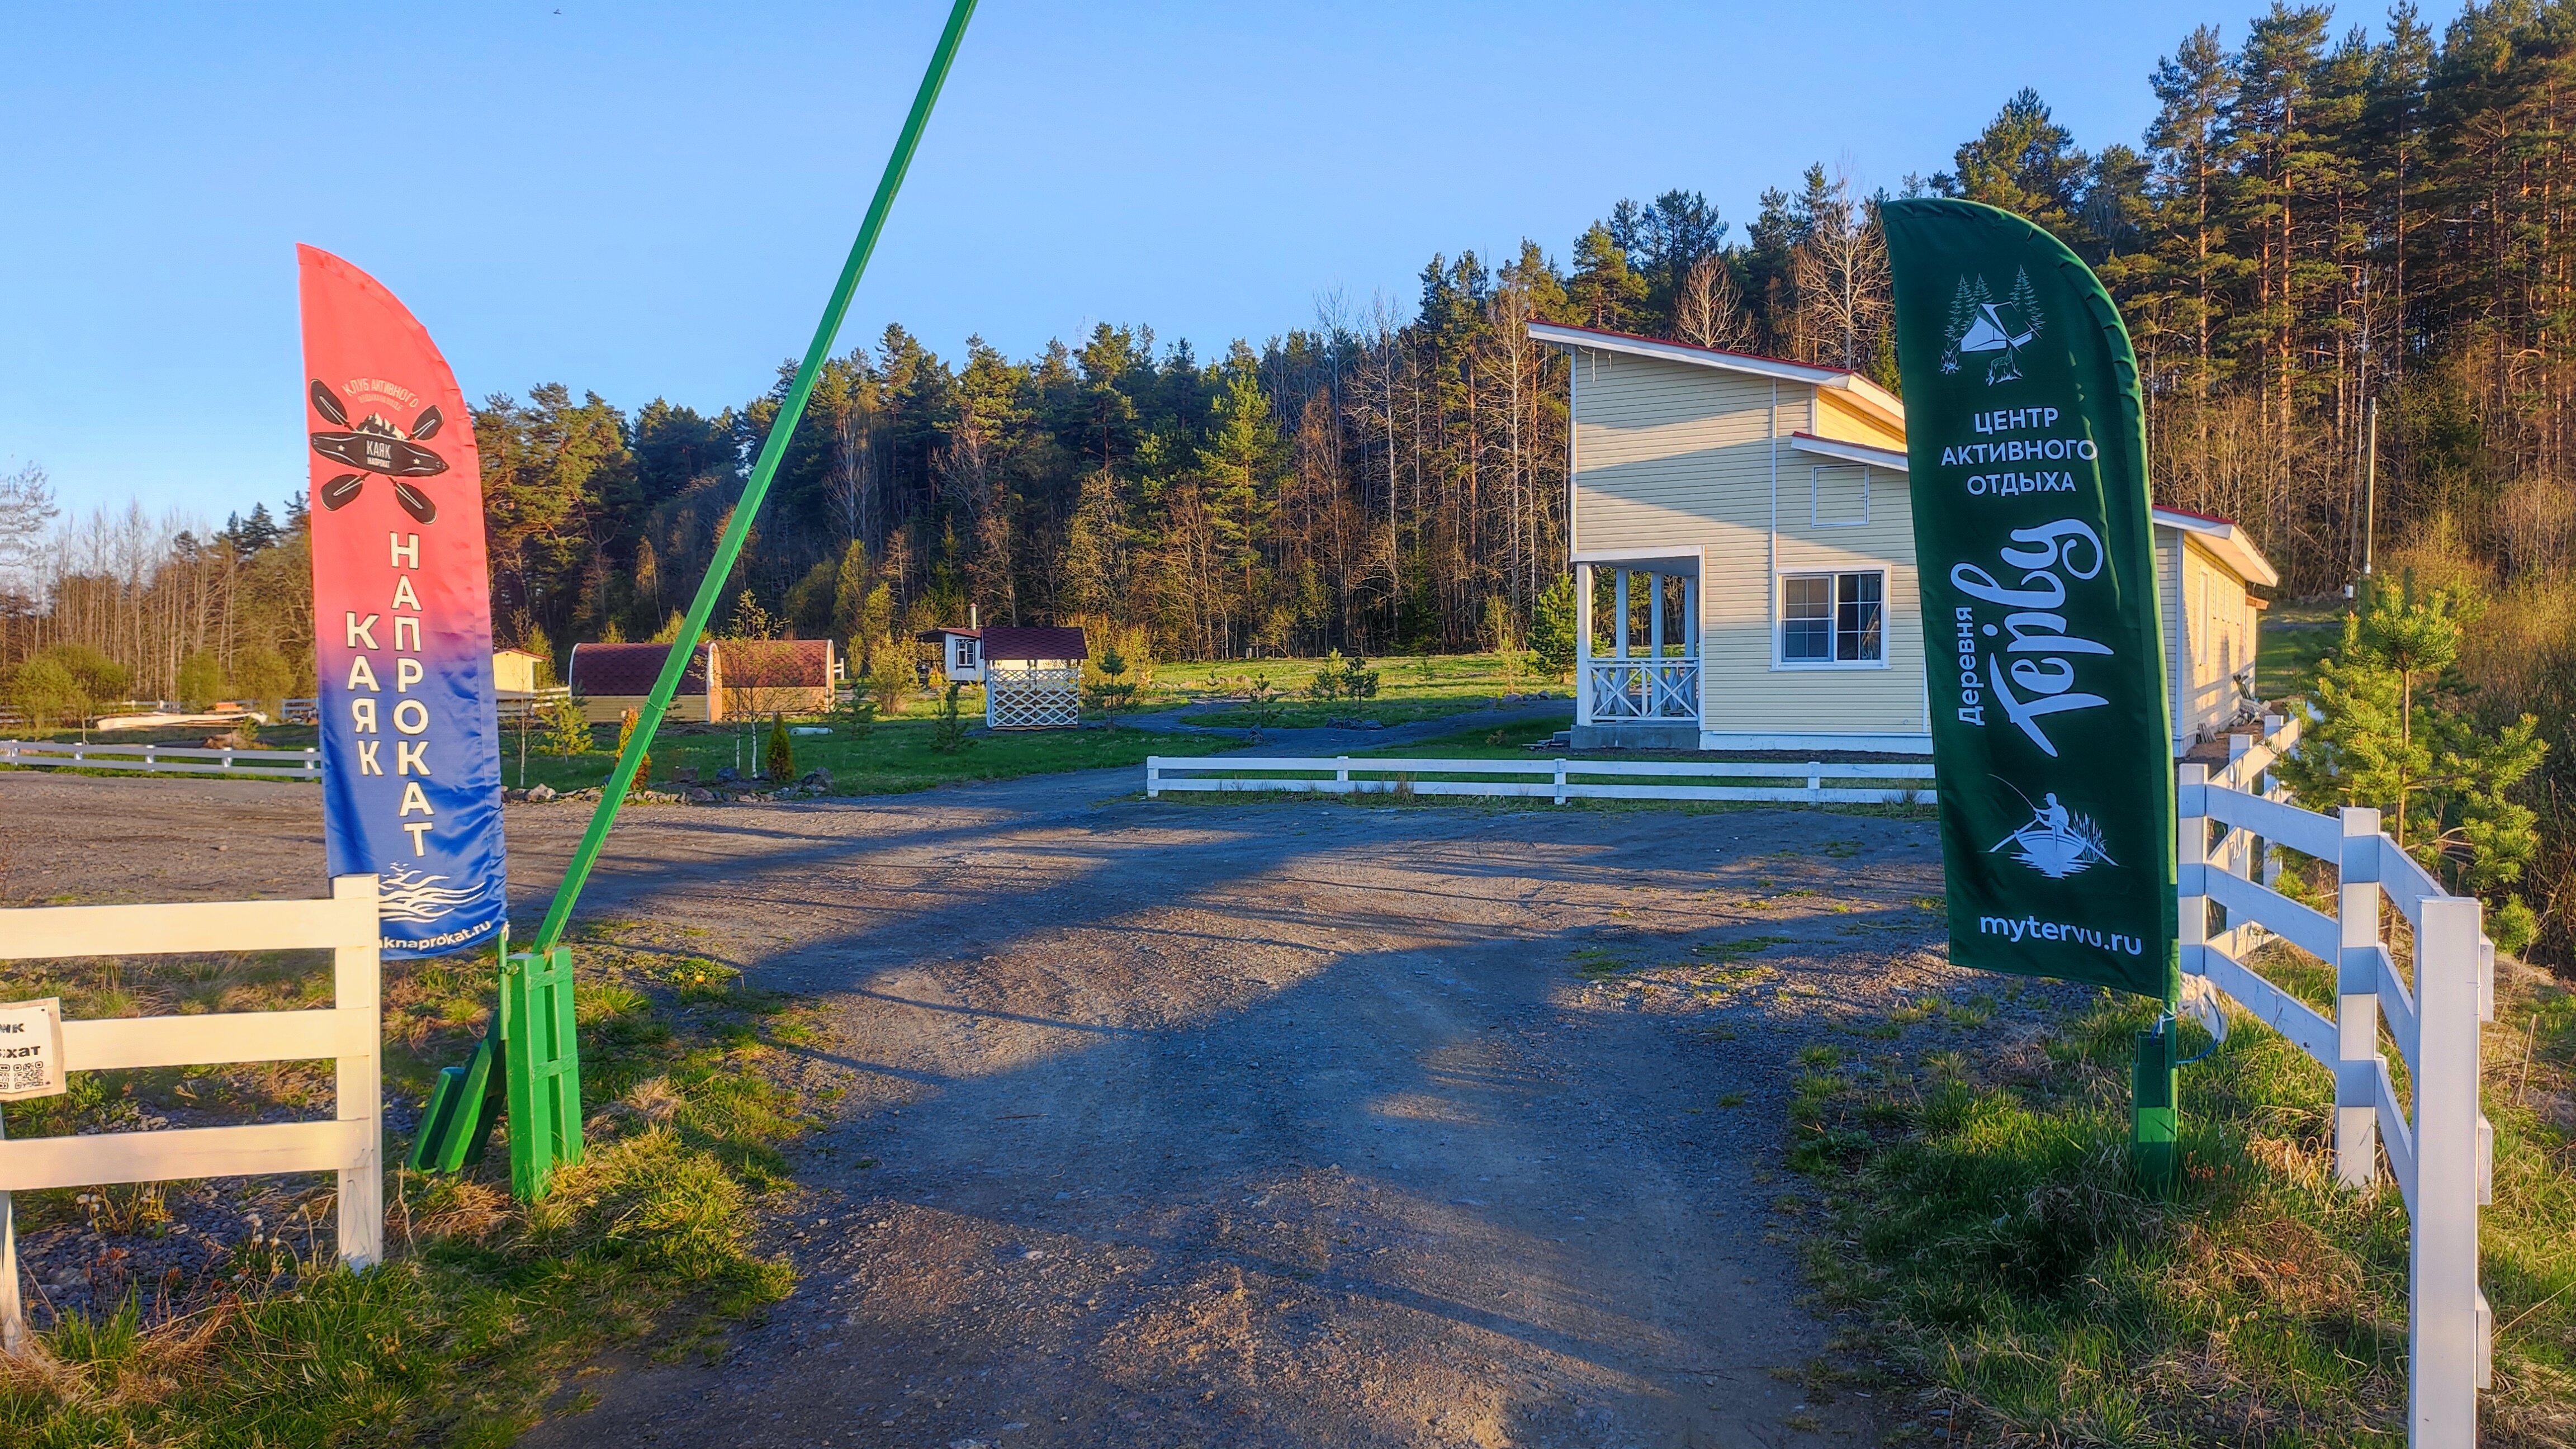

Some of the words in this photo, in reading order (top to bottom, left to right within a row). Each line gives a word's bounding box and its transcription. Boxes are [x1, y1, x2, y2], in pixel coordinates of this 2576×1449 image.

[341, 378, 369, 396] КЛУБ
[371, 378, 419, 408] АКТИВНОГО
[1974, 407, 2059, 435] ЦЕНТР
[366, 439, 391, 459] КАЯК
[1940, 439, 2098, 466] АКТИВНОГО
[1966, 471, 2077, 497] ОТДЫХА
[1955, 607, 1985, 726] Деревня
[345, 610, 385, 776] КАЯК
[389, 531, 434, 857] НАПРОКАТ
[1980, 915, 2142, 955] mytervu.ru
